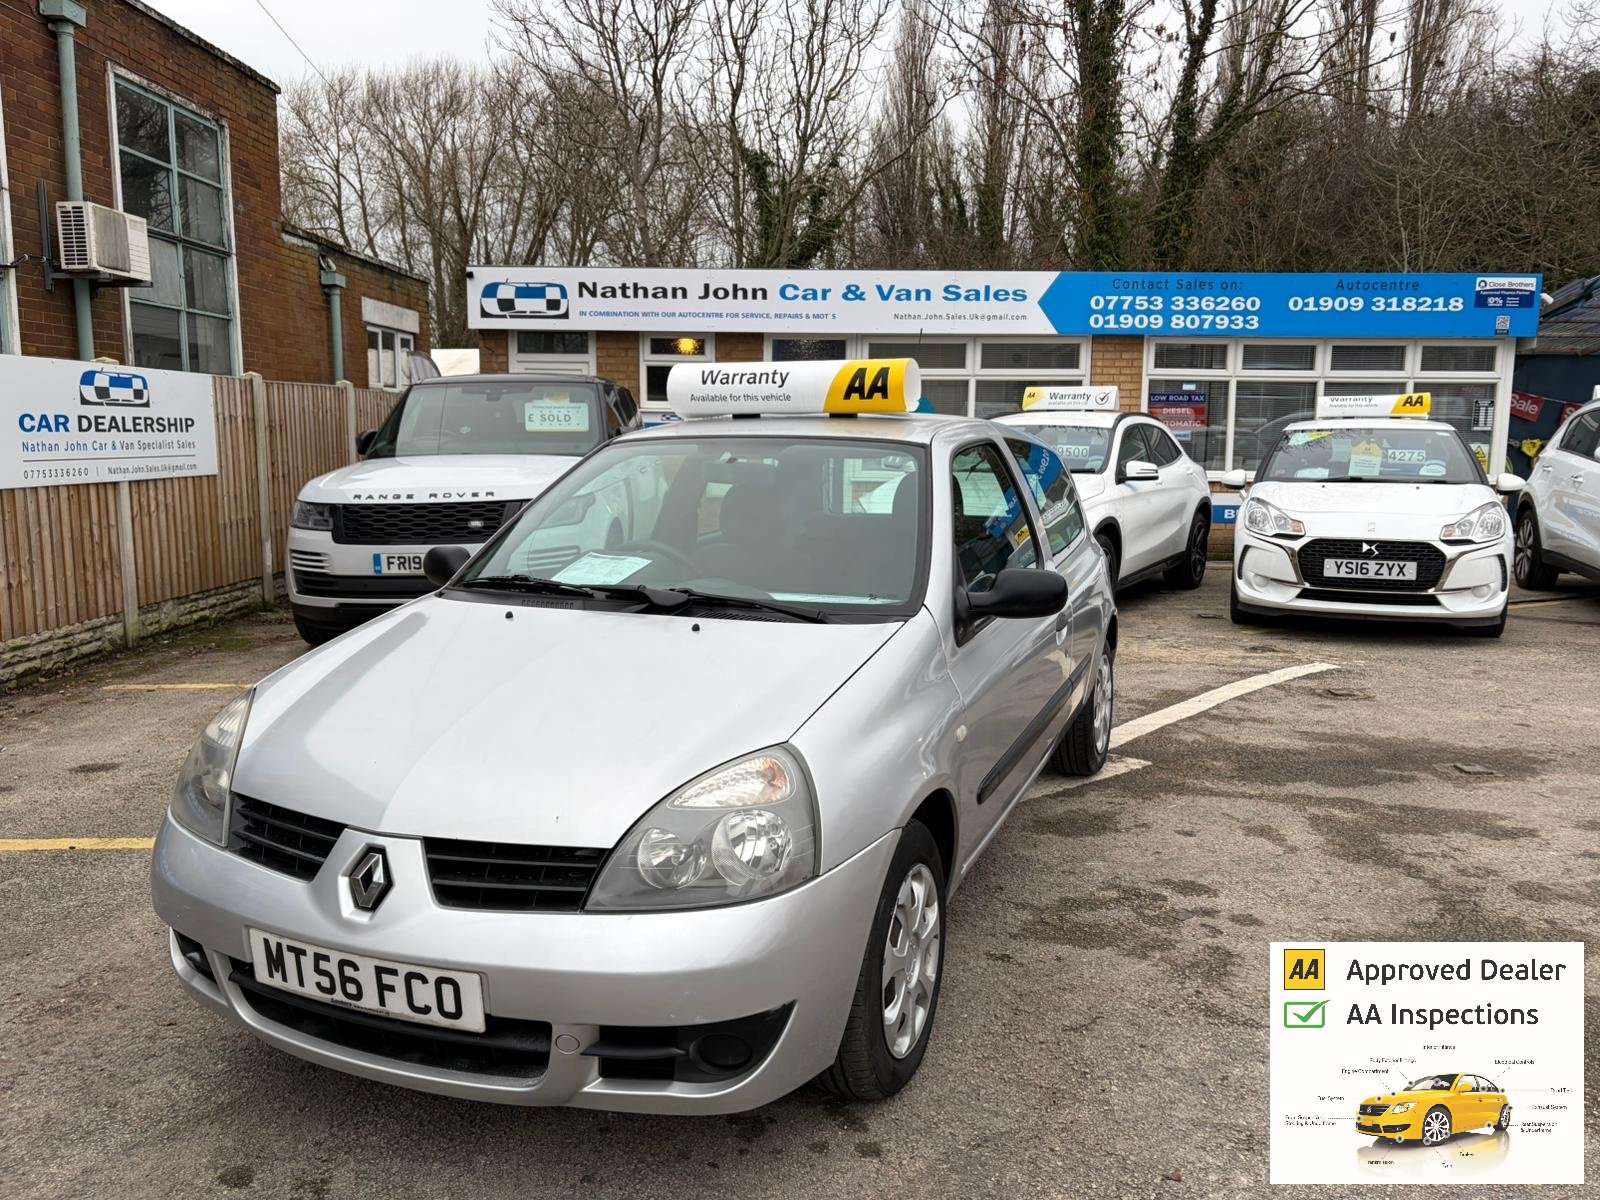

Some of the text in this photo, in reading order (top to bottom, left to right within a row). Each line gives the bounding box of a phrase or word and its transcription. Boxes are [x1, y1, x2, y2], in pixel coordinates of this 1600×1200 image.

[577, 281, 1028, 302] Nathan John Car & Van Sales
[1112, 279, 1243, 291] Contact Sales on:
[1335, 279, 1420, 291] Autocentre
[1089, 295, 1261, 311] 07753 336260
[1288, 296, 1464, 312] 01909 318218
[741, 312, 773, 320] SERVICE,
[893, 313, 1028, 322] Nathan.John.Sales.Uk@gmail.com
[1089, 313, 1259, 329] 01909 807933
[701, 369, 790, 388] Warranty
[843, 367, 890, 401] AA
[690, 392, 792, 403] Available for this vehicle
[1049, 392, 1092, 401] Warranty
[1402, 395, 1424, 407] AA
[1162, 407, 1193, 415] DIESEL
[18, 413, 195, 433] CAR DEALERSHIP
[540, 413, 572, 423] SOLD
[22, 439, 196, 453] Nathan John Car & Van Specialist Sales
[1057, 446, 1088, 458] 9500
[1388, 450, 1425, 463] 4275
[23, 463, 197, 480] 07753336260 Nathan.John.Sales.Uk@gmail.com
[428, 491, 495, 499] ROVER
[387, 555, 422, 571] FR19
[1334, 560, 1408, 578] YS16 ZYX
[263, 937, 463, 1021] MT56 FCO
